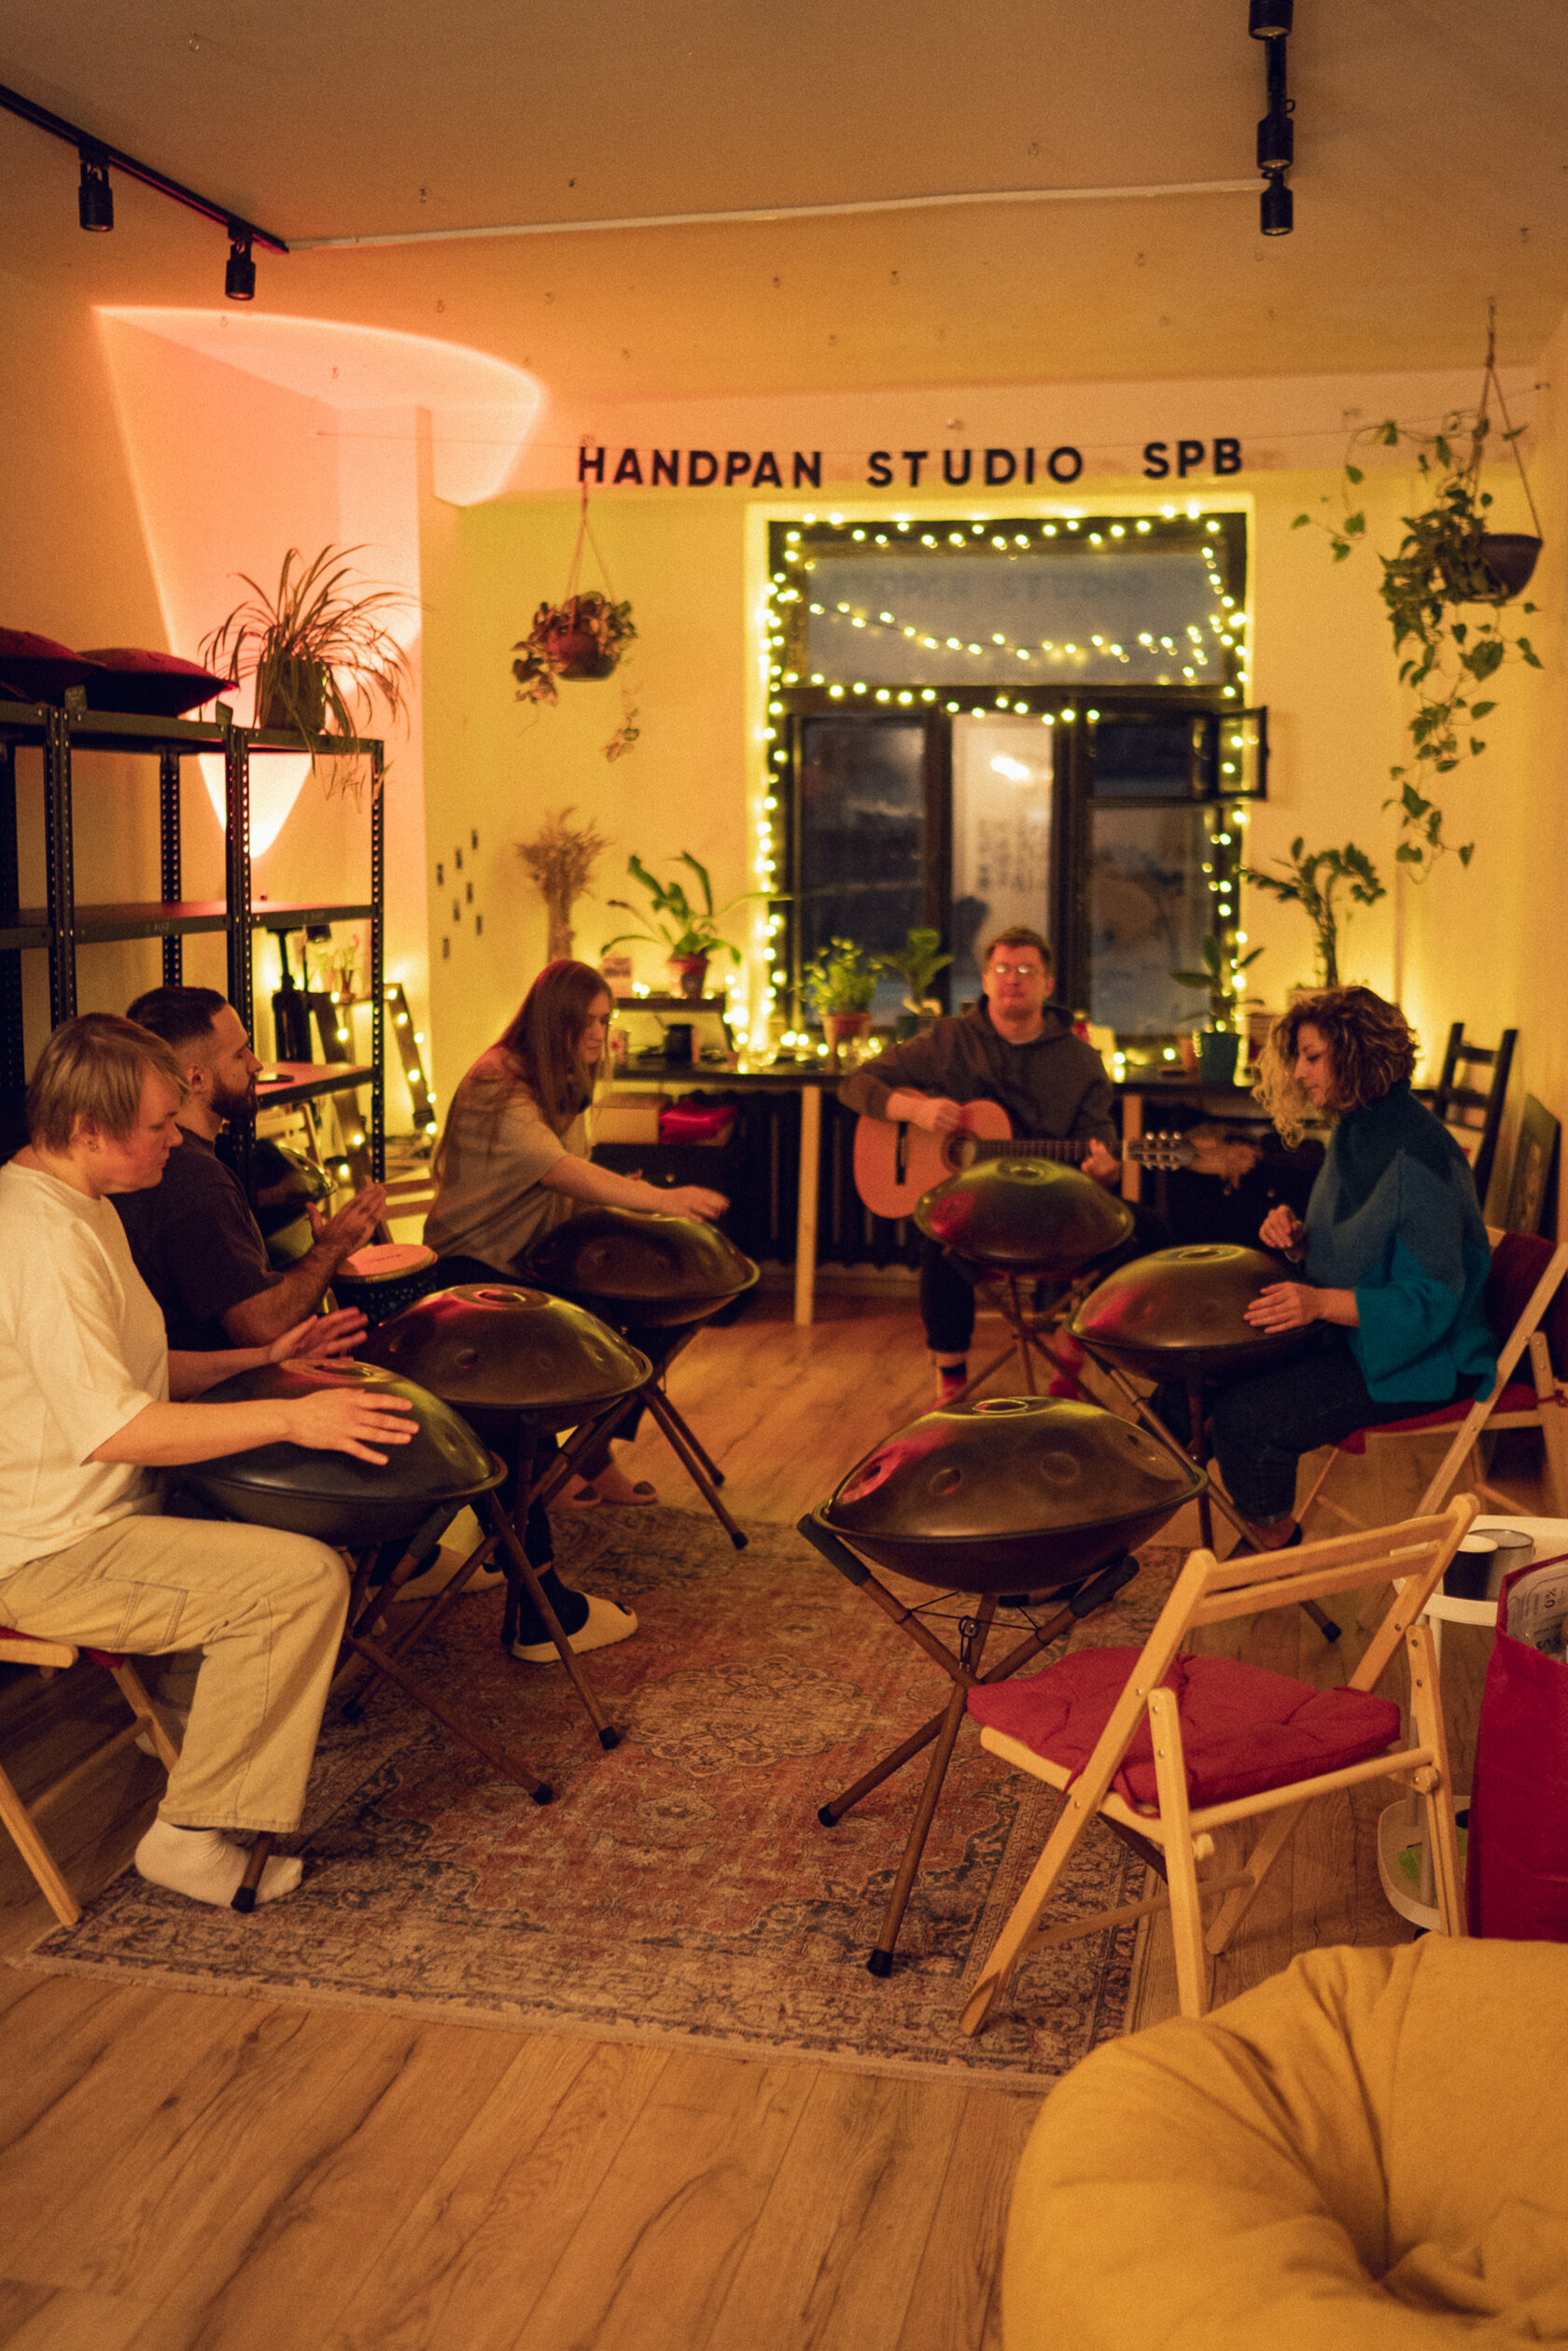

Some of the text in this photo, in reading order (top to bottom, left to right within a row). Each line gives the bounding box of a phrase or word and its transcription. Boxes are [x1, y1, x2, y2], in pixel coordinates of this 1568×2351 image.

[578, 438, 1242, 488] HANDPAN STUDIO SPB
